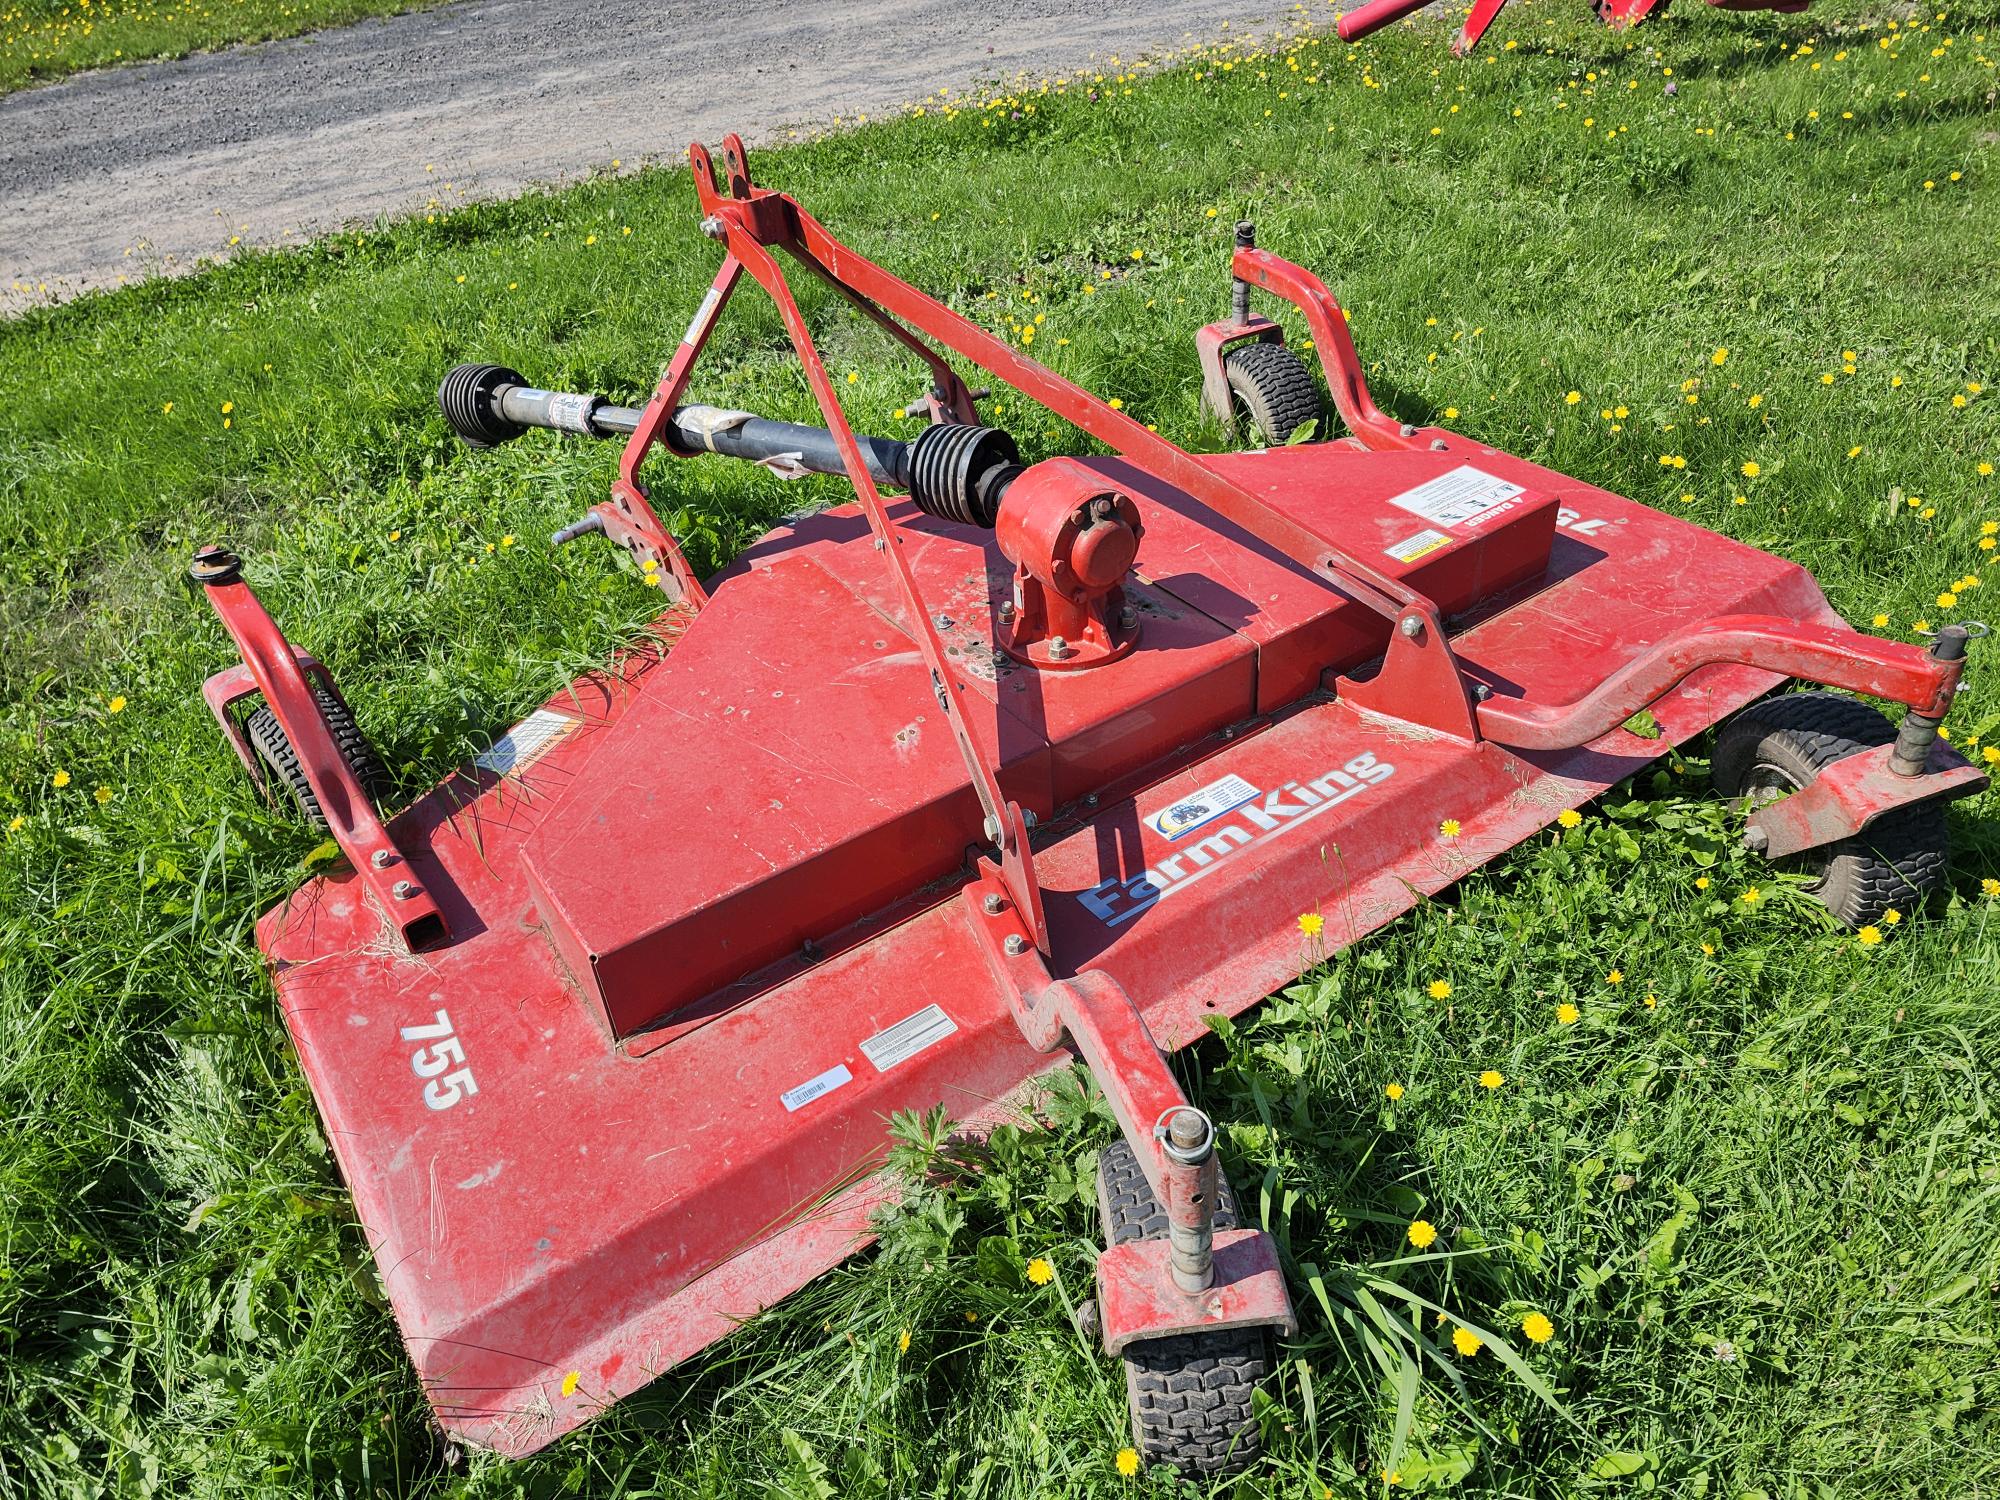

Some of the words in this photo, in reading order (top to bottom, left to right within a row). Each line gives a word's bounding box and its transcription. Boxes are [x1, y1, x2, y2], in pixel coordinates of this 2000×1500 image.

[1463, 501, 1514, 527] DANGER
[518, 738, 554, 768] WARNING
[1076, 824, 1254, 920] Farm
[1239, 749, 1396, 831] King
[400, 1008, 479, 1111] 755
